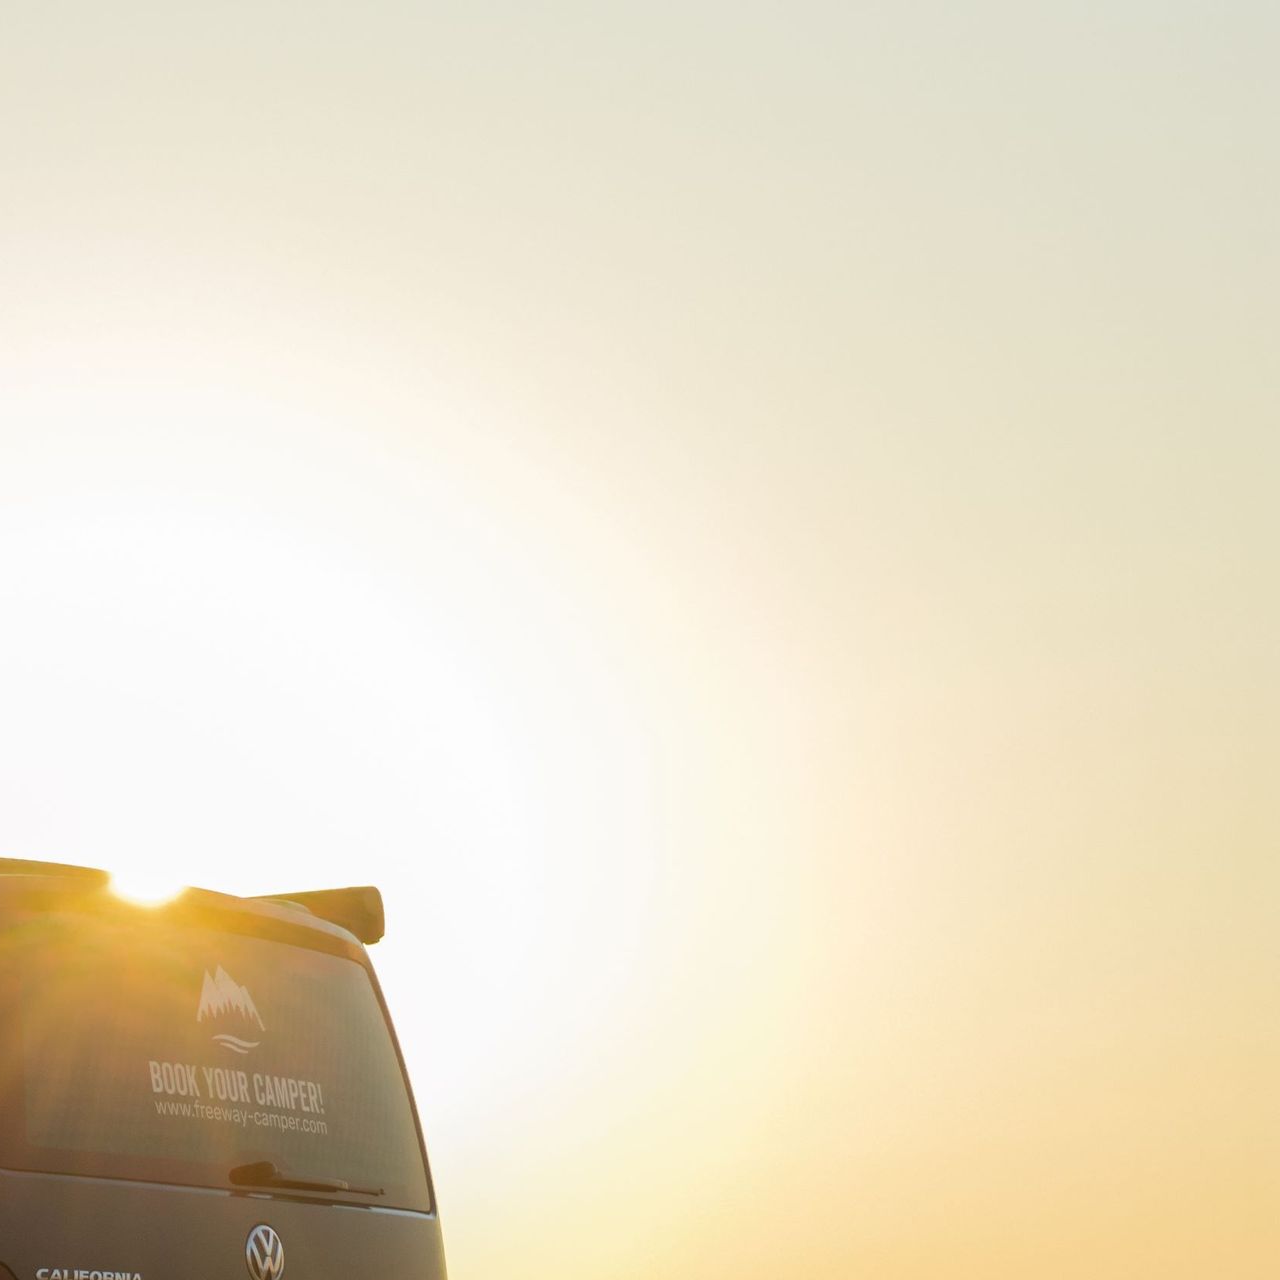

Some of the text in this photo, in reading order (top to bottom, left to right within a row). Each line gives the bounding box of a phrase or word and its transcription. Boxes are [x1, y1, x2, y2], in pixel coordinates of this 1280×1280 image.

[149, 1060, 325, 1114] BOOK YOUR CAMPER!
[154, 1100, 328, 1135] www.freeway-camper.com
